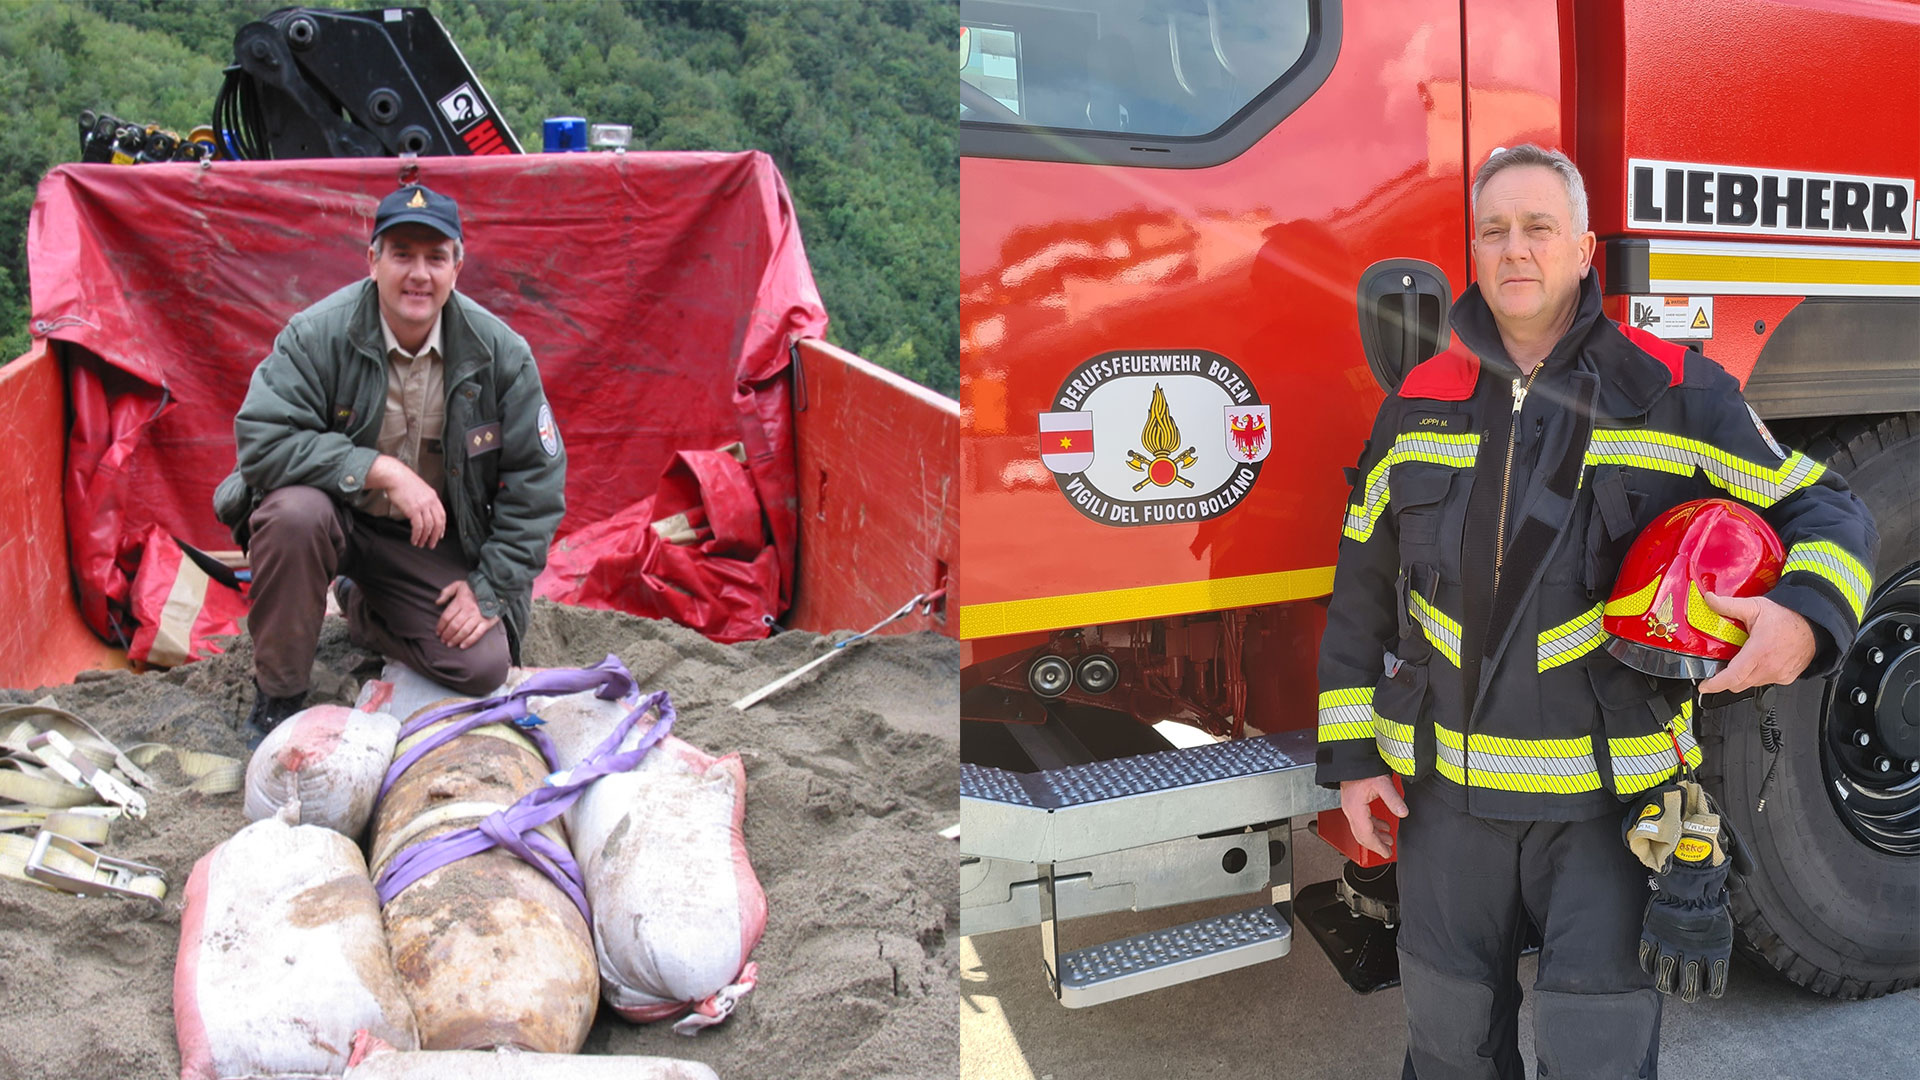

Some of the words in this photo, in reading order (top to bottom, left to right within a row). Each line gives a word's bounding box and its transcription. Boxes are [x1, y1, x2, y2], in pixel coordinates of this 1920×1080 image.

[1633, 166, 1908, 233] LIEBHERR
[1059, 355, 1202, 411] BERUFSFEUERWEHR
[1208, 360, 1252, 404] BOZEN
[1419, 418, 1439, 426] JOPPI
[1065, 476, 1108, 518] VIGILI
[1110, 504, 1139, 523] DEL
[1144, 502, 1197, 522] FUOCO
[1199, 467, 1255, 517] BOLZANO
